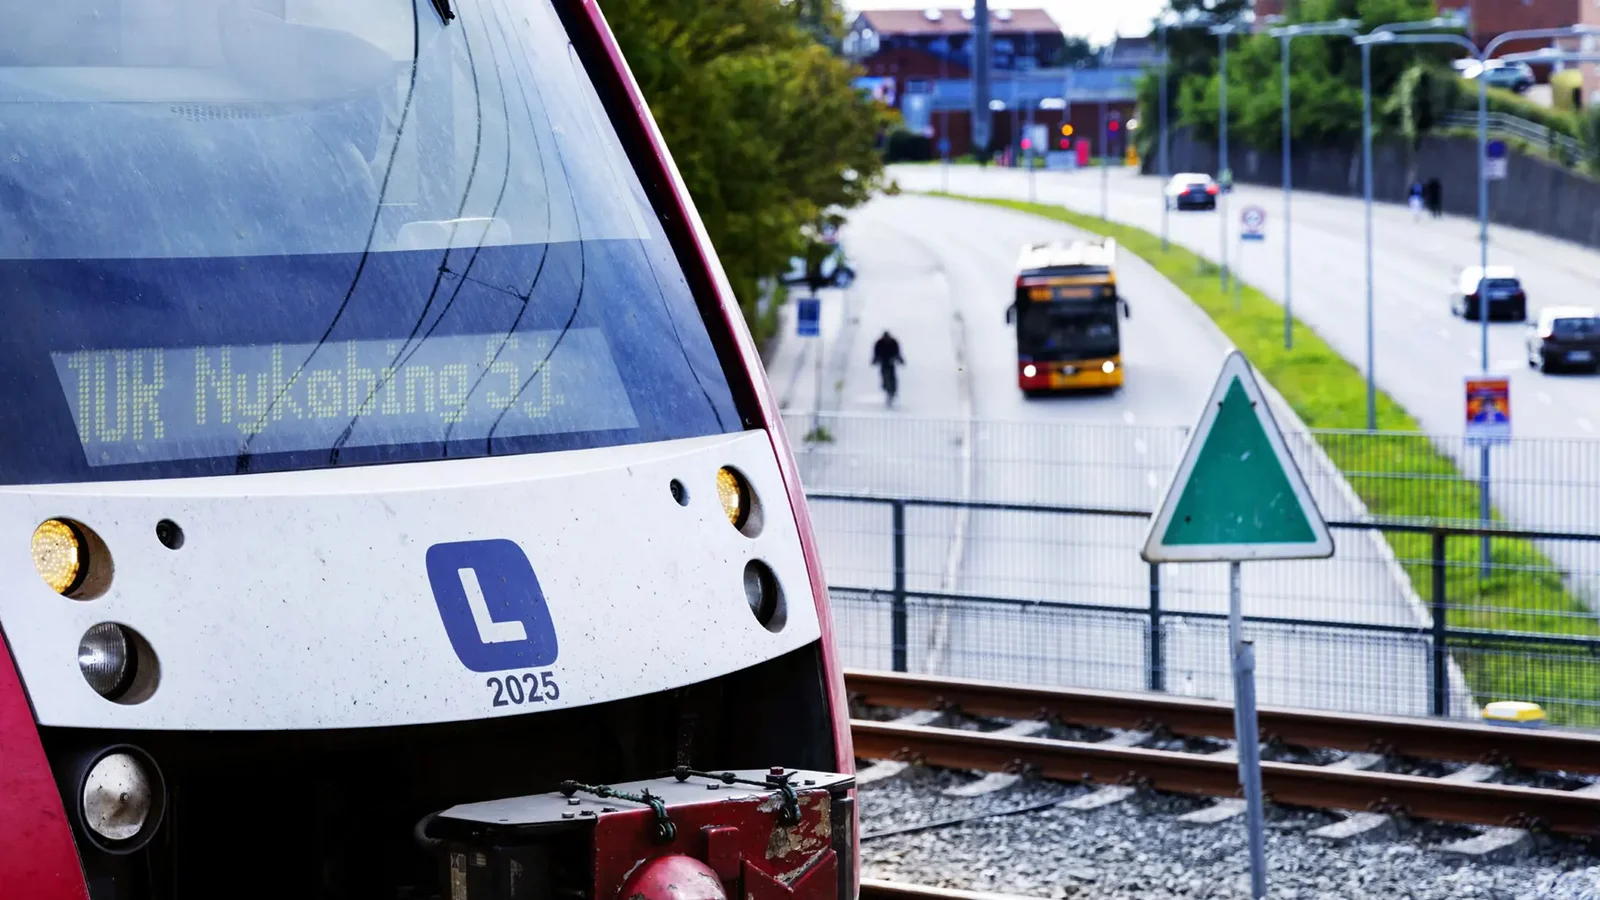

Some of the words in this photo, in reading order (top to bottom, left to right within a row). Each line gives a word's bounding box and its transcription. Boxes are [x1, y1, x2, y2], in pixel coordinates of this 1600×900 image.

[195, 339, 468, 435] Nykøbing
[457, 567, 528, 644] L
[486, 671, 560, 707] 2025
